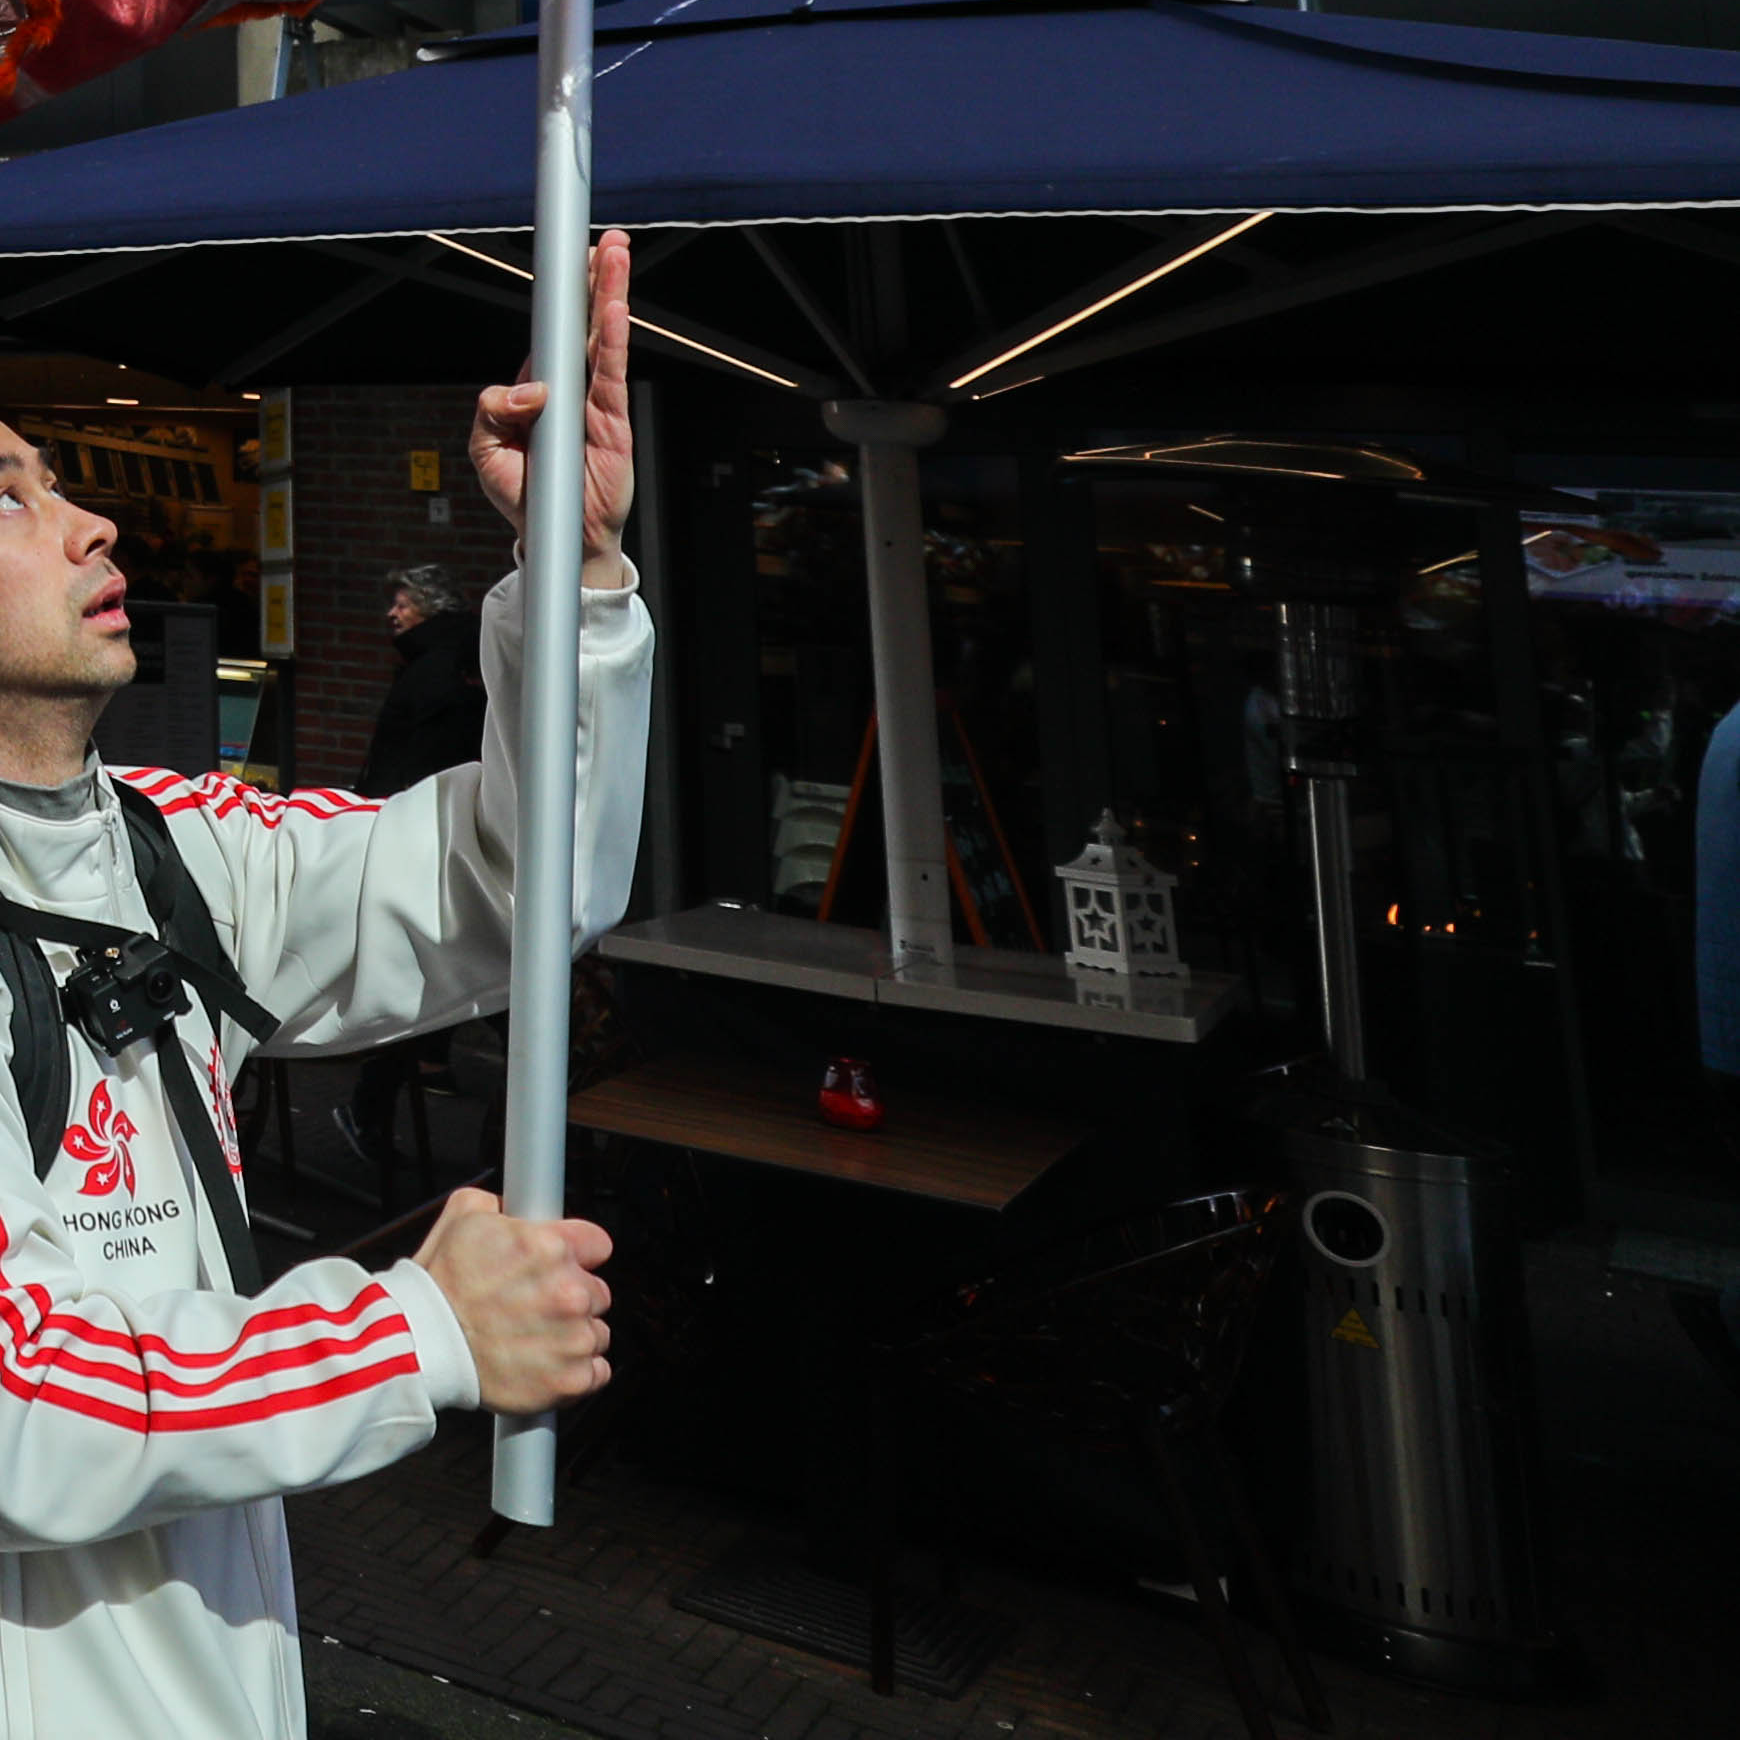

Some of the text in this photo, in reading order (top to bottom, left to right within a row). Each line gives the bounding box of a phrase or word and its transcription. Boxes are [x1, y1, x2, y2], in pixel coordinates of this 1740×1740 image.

[63, 1200, 180, 1233] HONG KONG
[103, 1236, 157, 1260] CHINA
